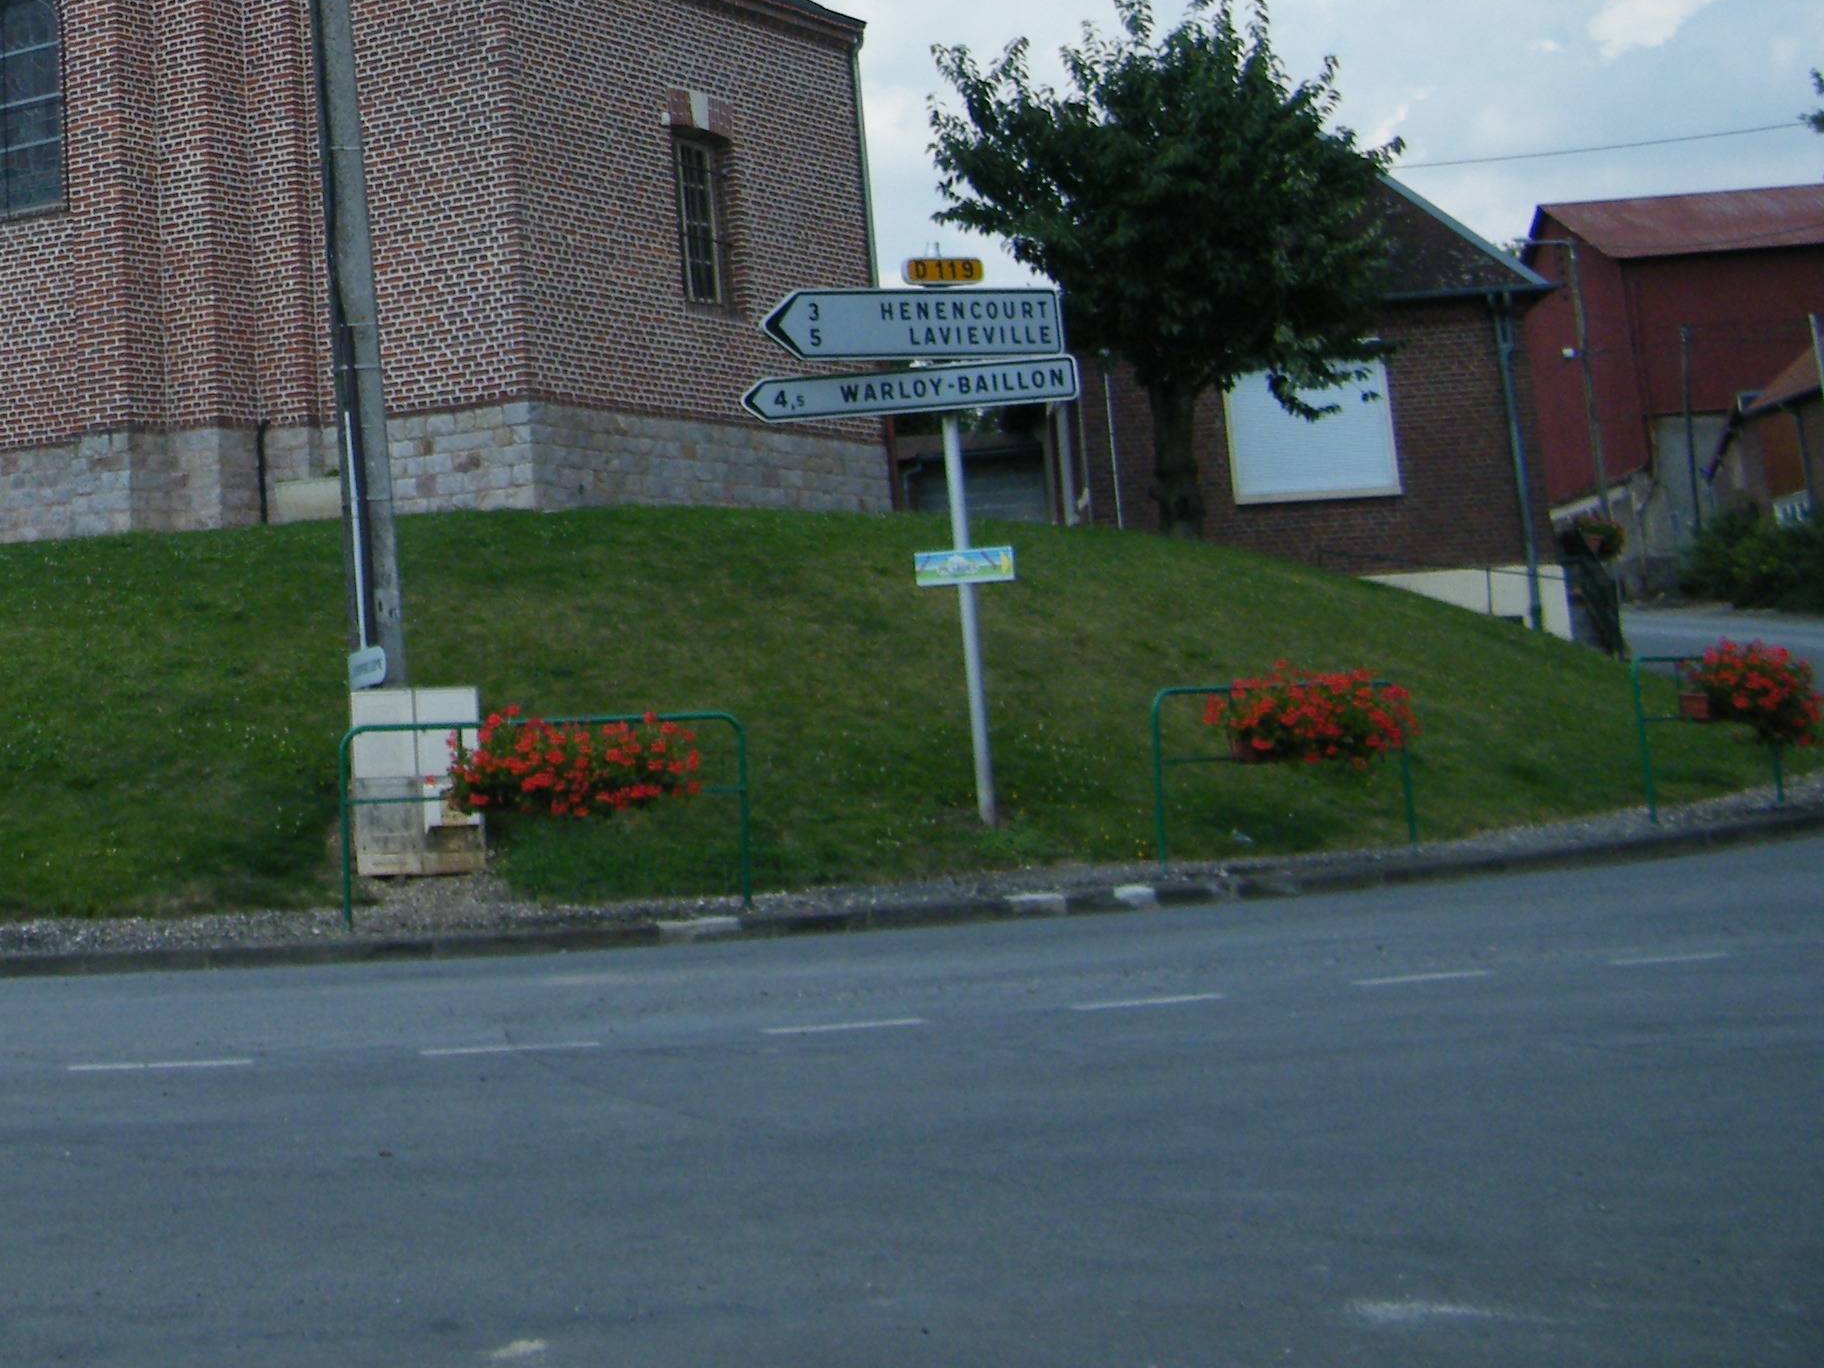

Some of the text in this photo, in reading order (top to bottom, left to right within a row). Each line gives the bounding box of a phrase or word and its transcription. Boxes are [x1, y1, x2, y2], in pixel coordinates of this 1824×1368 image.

[914, 260, 974, 280] D 119
[808, 301, 1048, 322] 3 HENENCOURT
[809, 326, 1053, 347] 5 LAVIEVILLE
[774, 368, 1065, 410] 4,5 WARLOY-BAILLON
